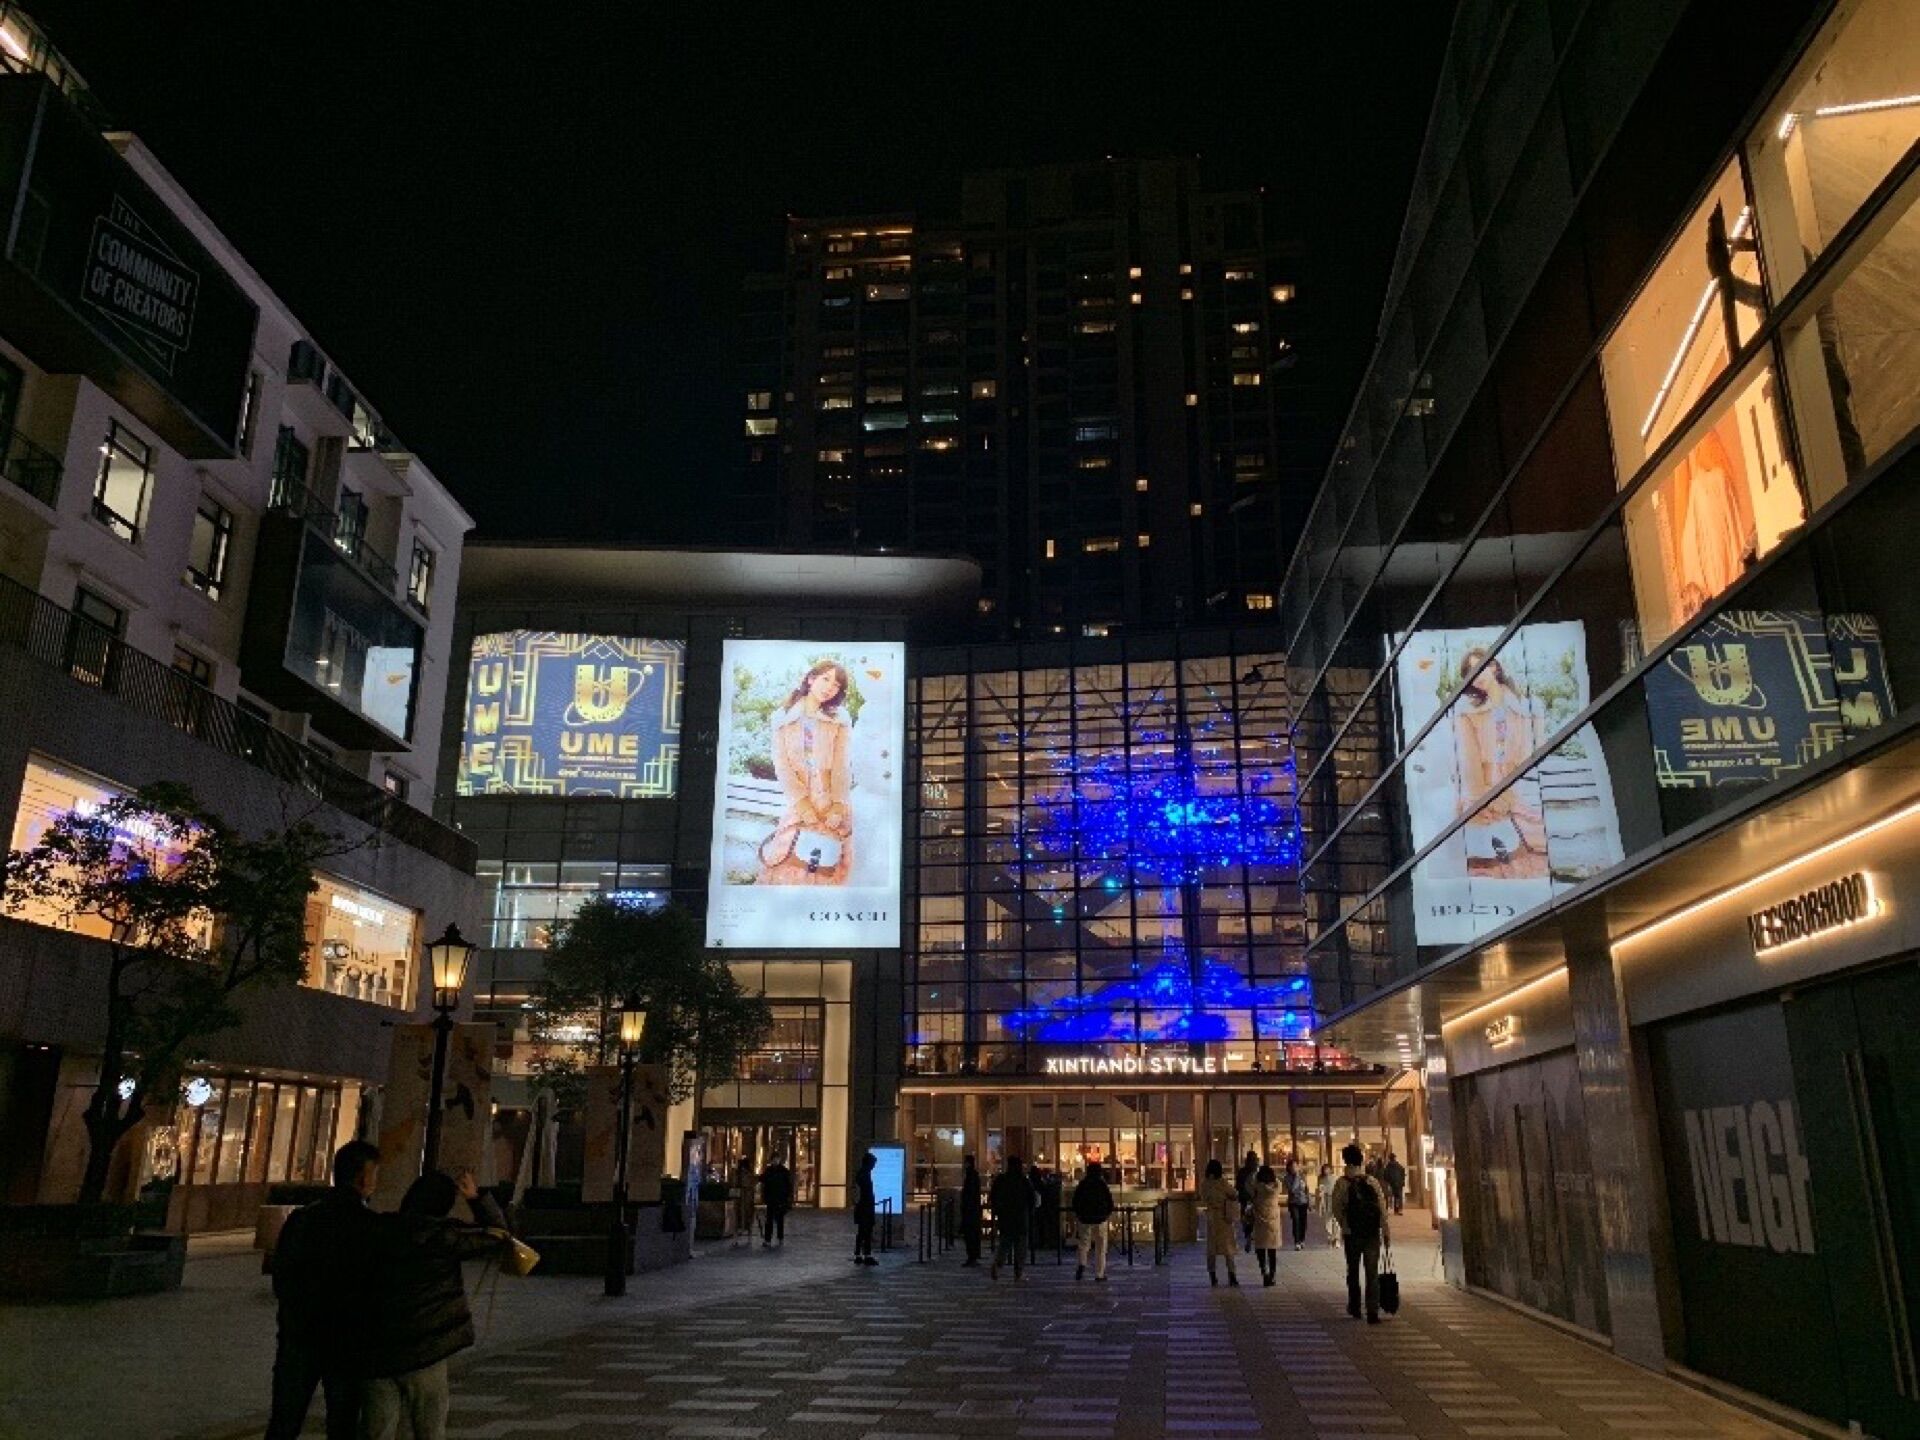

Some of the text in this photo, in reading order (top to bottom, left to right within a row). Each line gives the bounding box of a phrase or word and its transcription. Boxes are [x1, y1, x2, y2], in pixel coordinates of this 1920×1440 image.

[117, 202, 140, 234] THE
[97, 231, 192, 307] COMMUNITY
[91, 266, 187, 337] OF CREATORS
[560, 731, 639, 756] UME
[810, 911, 888, 922] COACH
[1747, 872, 1873, 955] NEIGHBORHOOD
[1046, 1056, 1142, 1074] XINTIANDI
[1150, 1056, 1217, 1074] STYLE
